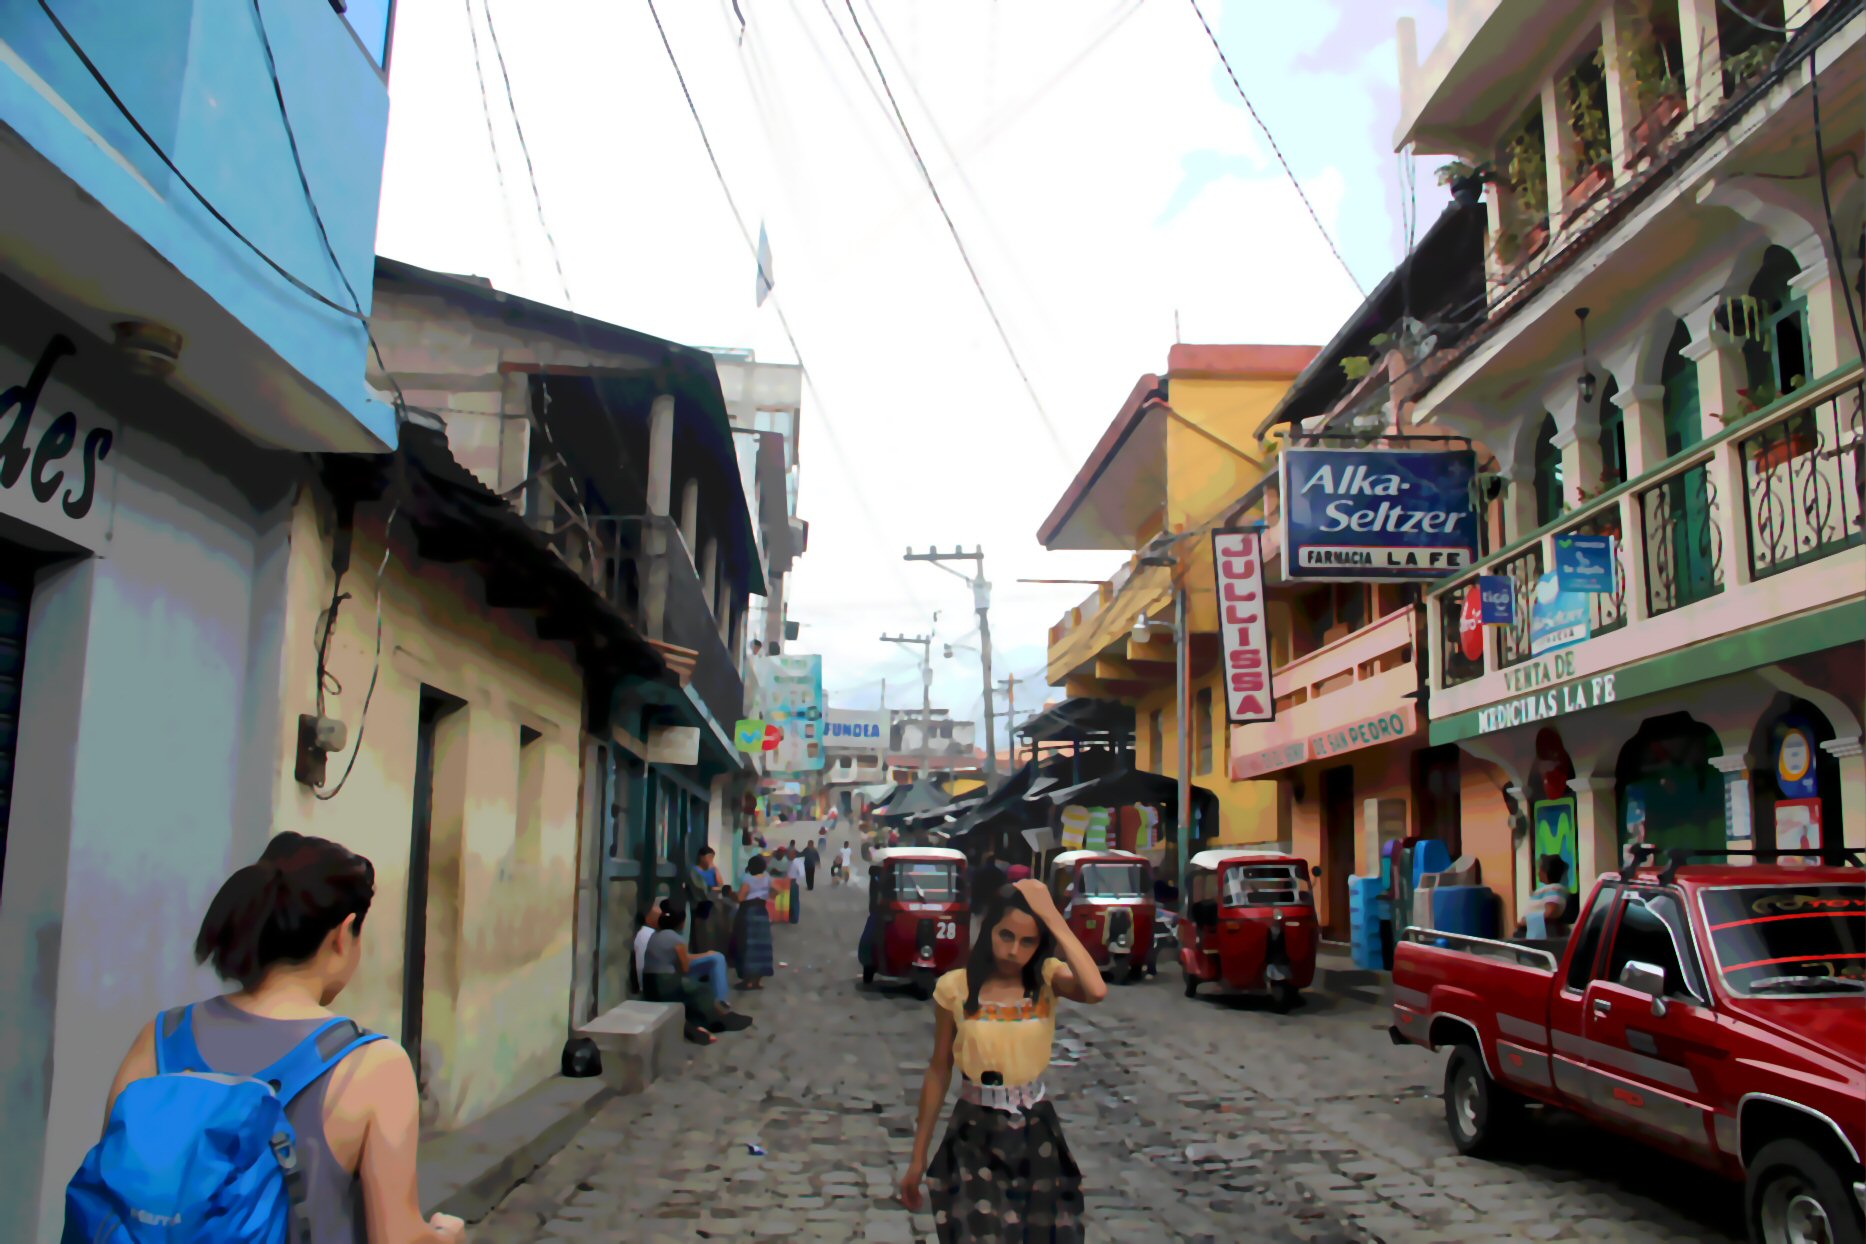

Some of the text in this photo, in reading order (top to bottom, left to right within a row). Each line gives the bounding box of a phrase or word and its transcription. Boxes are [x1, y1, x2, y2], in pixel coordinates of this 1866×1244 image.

[1301, 464, 1411, 496] Alka-
[1320, 500, 1467, 533] Seltzer
[1307, 550, 1461, 567] FARMACIA LA FE
[1221, 534, 1265, 715] JULLISSA
[1504, 651, 1576, 692] VENTA DE
[1478, 673, 1617, 734] MEDICINAS LA FE
[1349, 713, 1405, 745] PEDRO
[936, 922, 957, 939] 28
